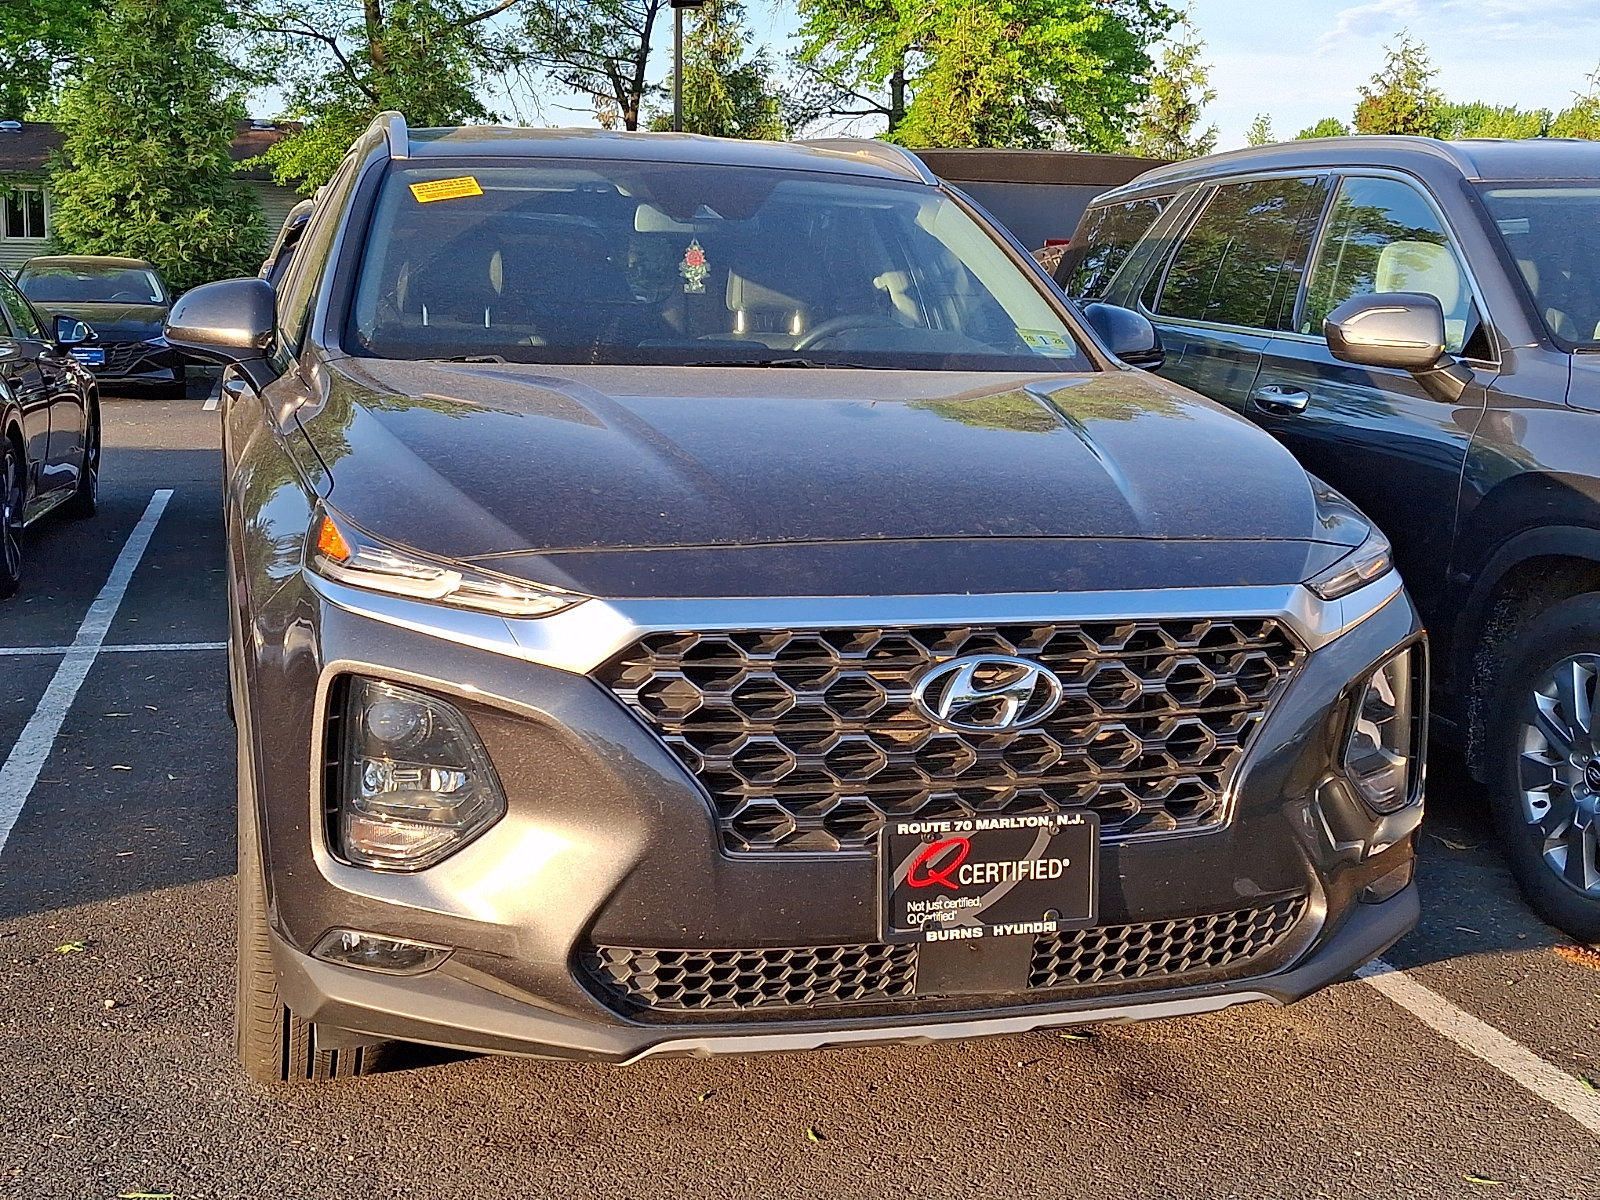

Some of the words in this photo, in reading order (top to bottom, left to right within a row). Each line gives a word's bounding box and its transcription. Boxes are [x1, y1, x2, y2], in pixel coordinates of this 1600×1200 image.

[897, 821, 951, 835] ROUTE
[953, 820, 973, 832] 70
[975, 815, 1054, 831] MARLTON,
[1056, 813, 1085, 826] N.J.
[906, 900, 925, 913] Not
[925, 899, 943, 913] just
[925, 926, 984, 943] BURNS
[992, 920, 1057, 937] HYUNDAI
